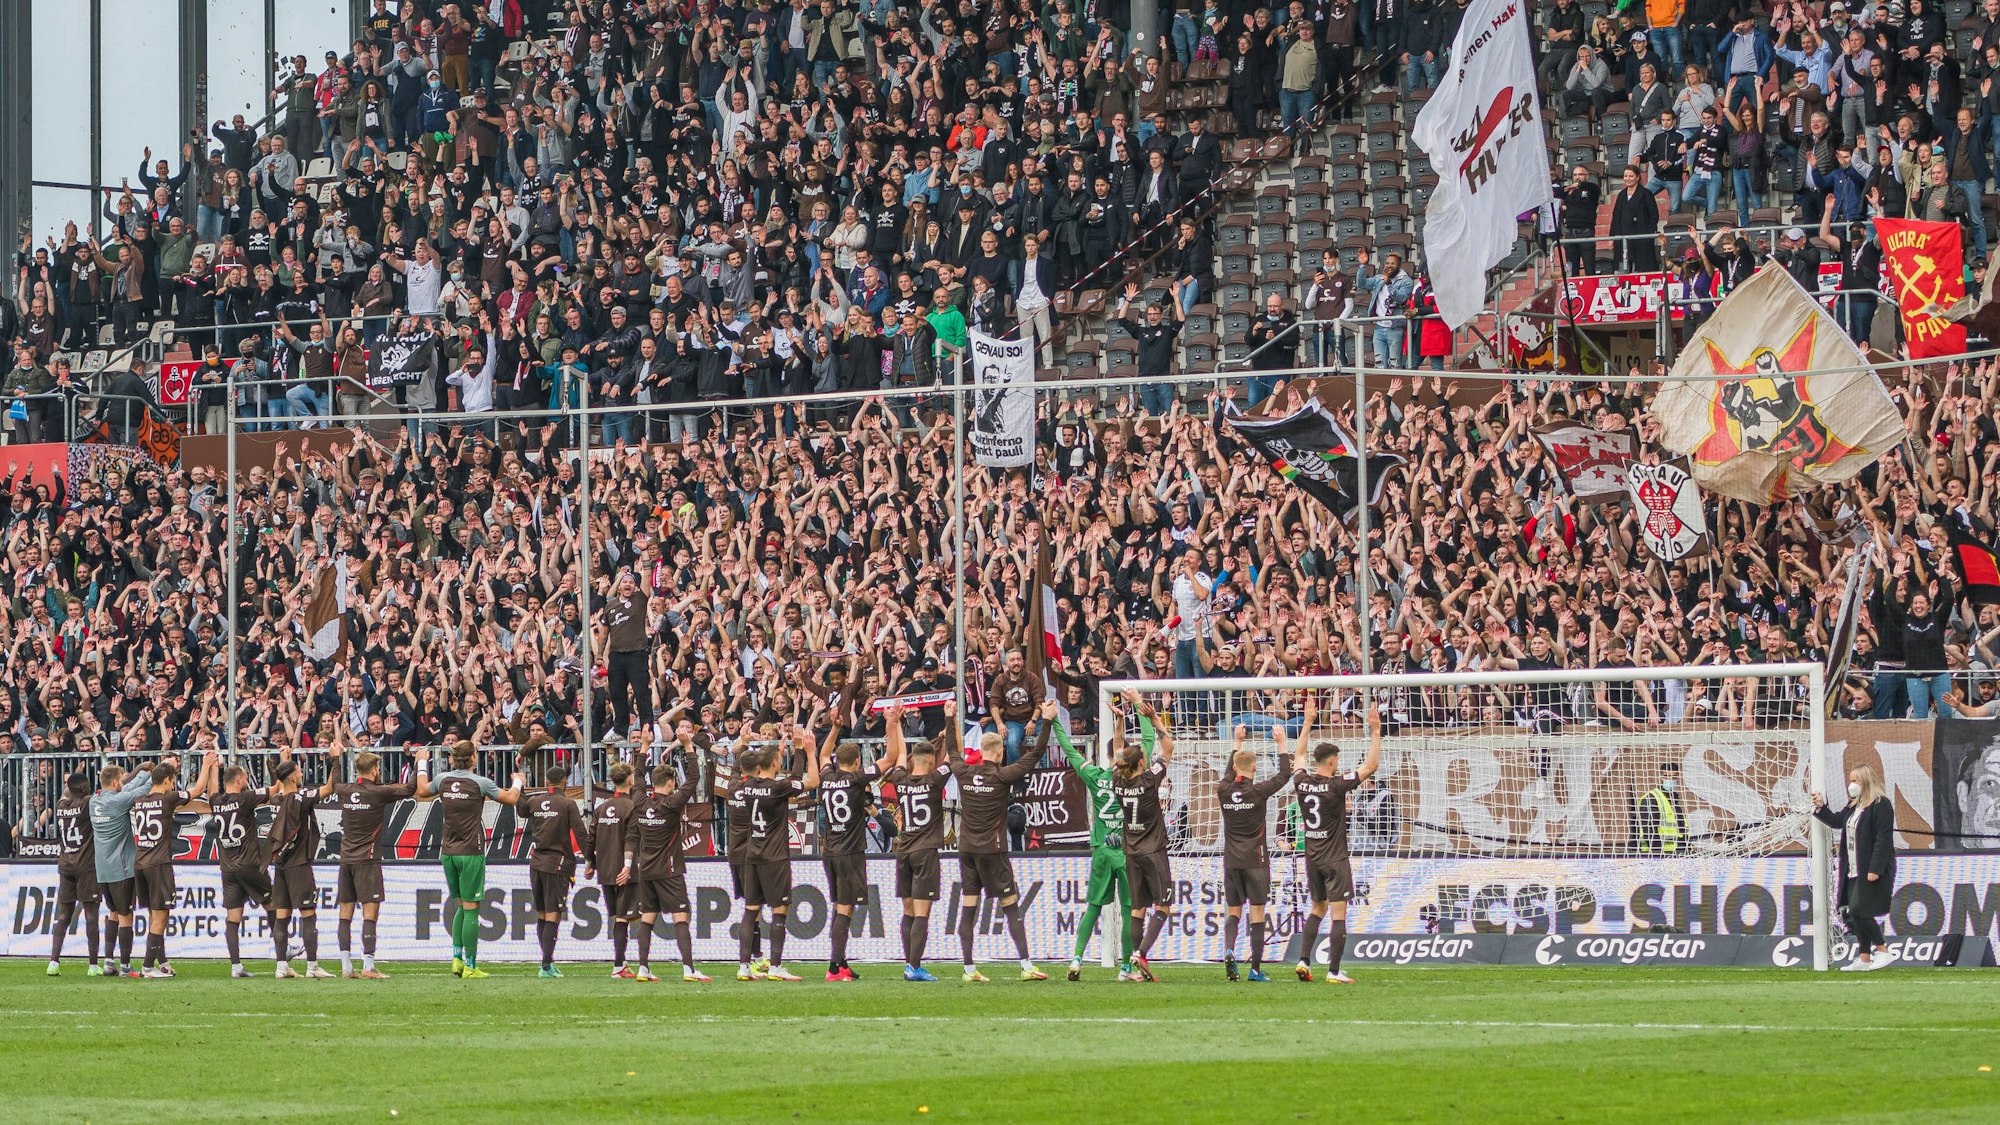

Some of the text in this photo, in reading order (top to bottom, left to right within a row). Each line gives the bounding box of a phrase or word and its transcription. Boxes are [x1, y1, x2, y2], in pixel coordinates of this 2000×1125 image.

[975, 341, 1023, 358] GENAU SO!
[975, 445, 1023, 459] ankt pauli
[831, 780, 850, 788] PAULI
[907, 784, 930, 794] PAULI
[963, 784, 994, 793] congstar
[1308, 783, 1329, 793] PAULI
[442, 792, 469, 800] congstar
[754, 788, 771, 796] PAULI
[1124, 786, 1145, 796] PAULI
[142, 799, 163, 809] PAULI
[221, 801, 239, 812] PAULI
[343, 803, 371, 811] congstar
[821, 789, 852, 824] 18
[1222, 803, 1254, 811] congstar
[63, 806, 81, 816] PAULI
[533, 810, 559, 819] congstar
[751, 799, 767, 831] 4
[900, 793, 931, 828] 15
[1122, 797, 1139, 825] 7
[1304, 794, 1321, 829] 3
[135, 810, 163, 840] 25
[214, 812, 246, 841] 26
[638, 818, 666, 826] congstar
[58, 817, 84, 847] 14
[195, 915, 219, 938] FC
[1168, 911, 1197, 937] FC
[1354, 934, 1473, 964] congstar
[1576, 933, 1706, 964] congstar
